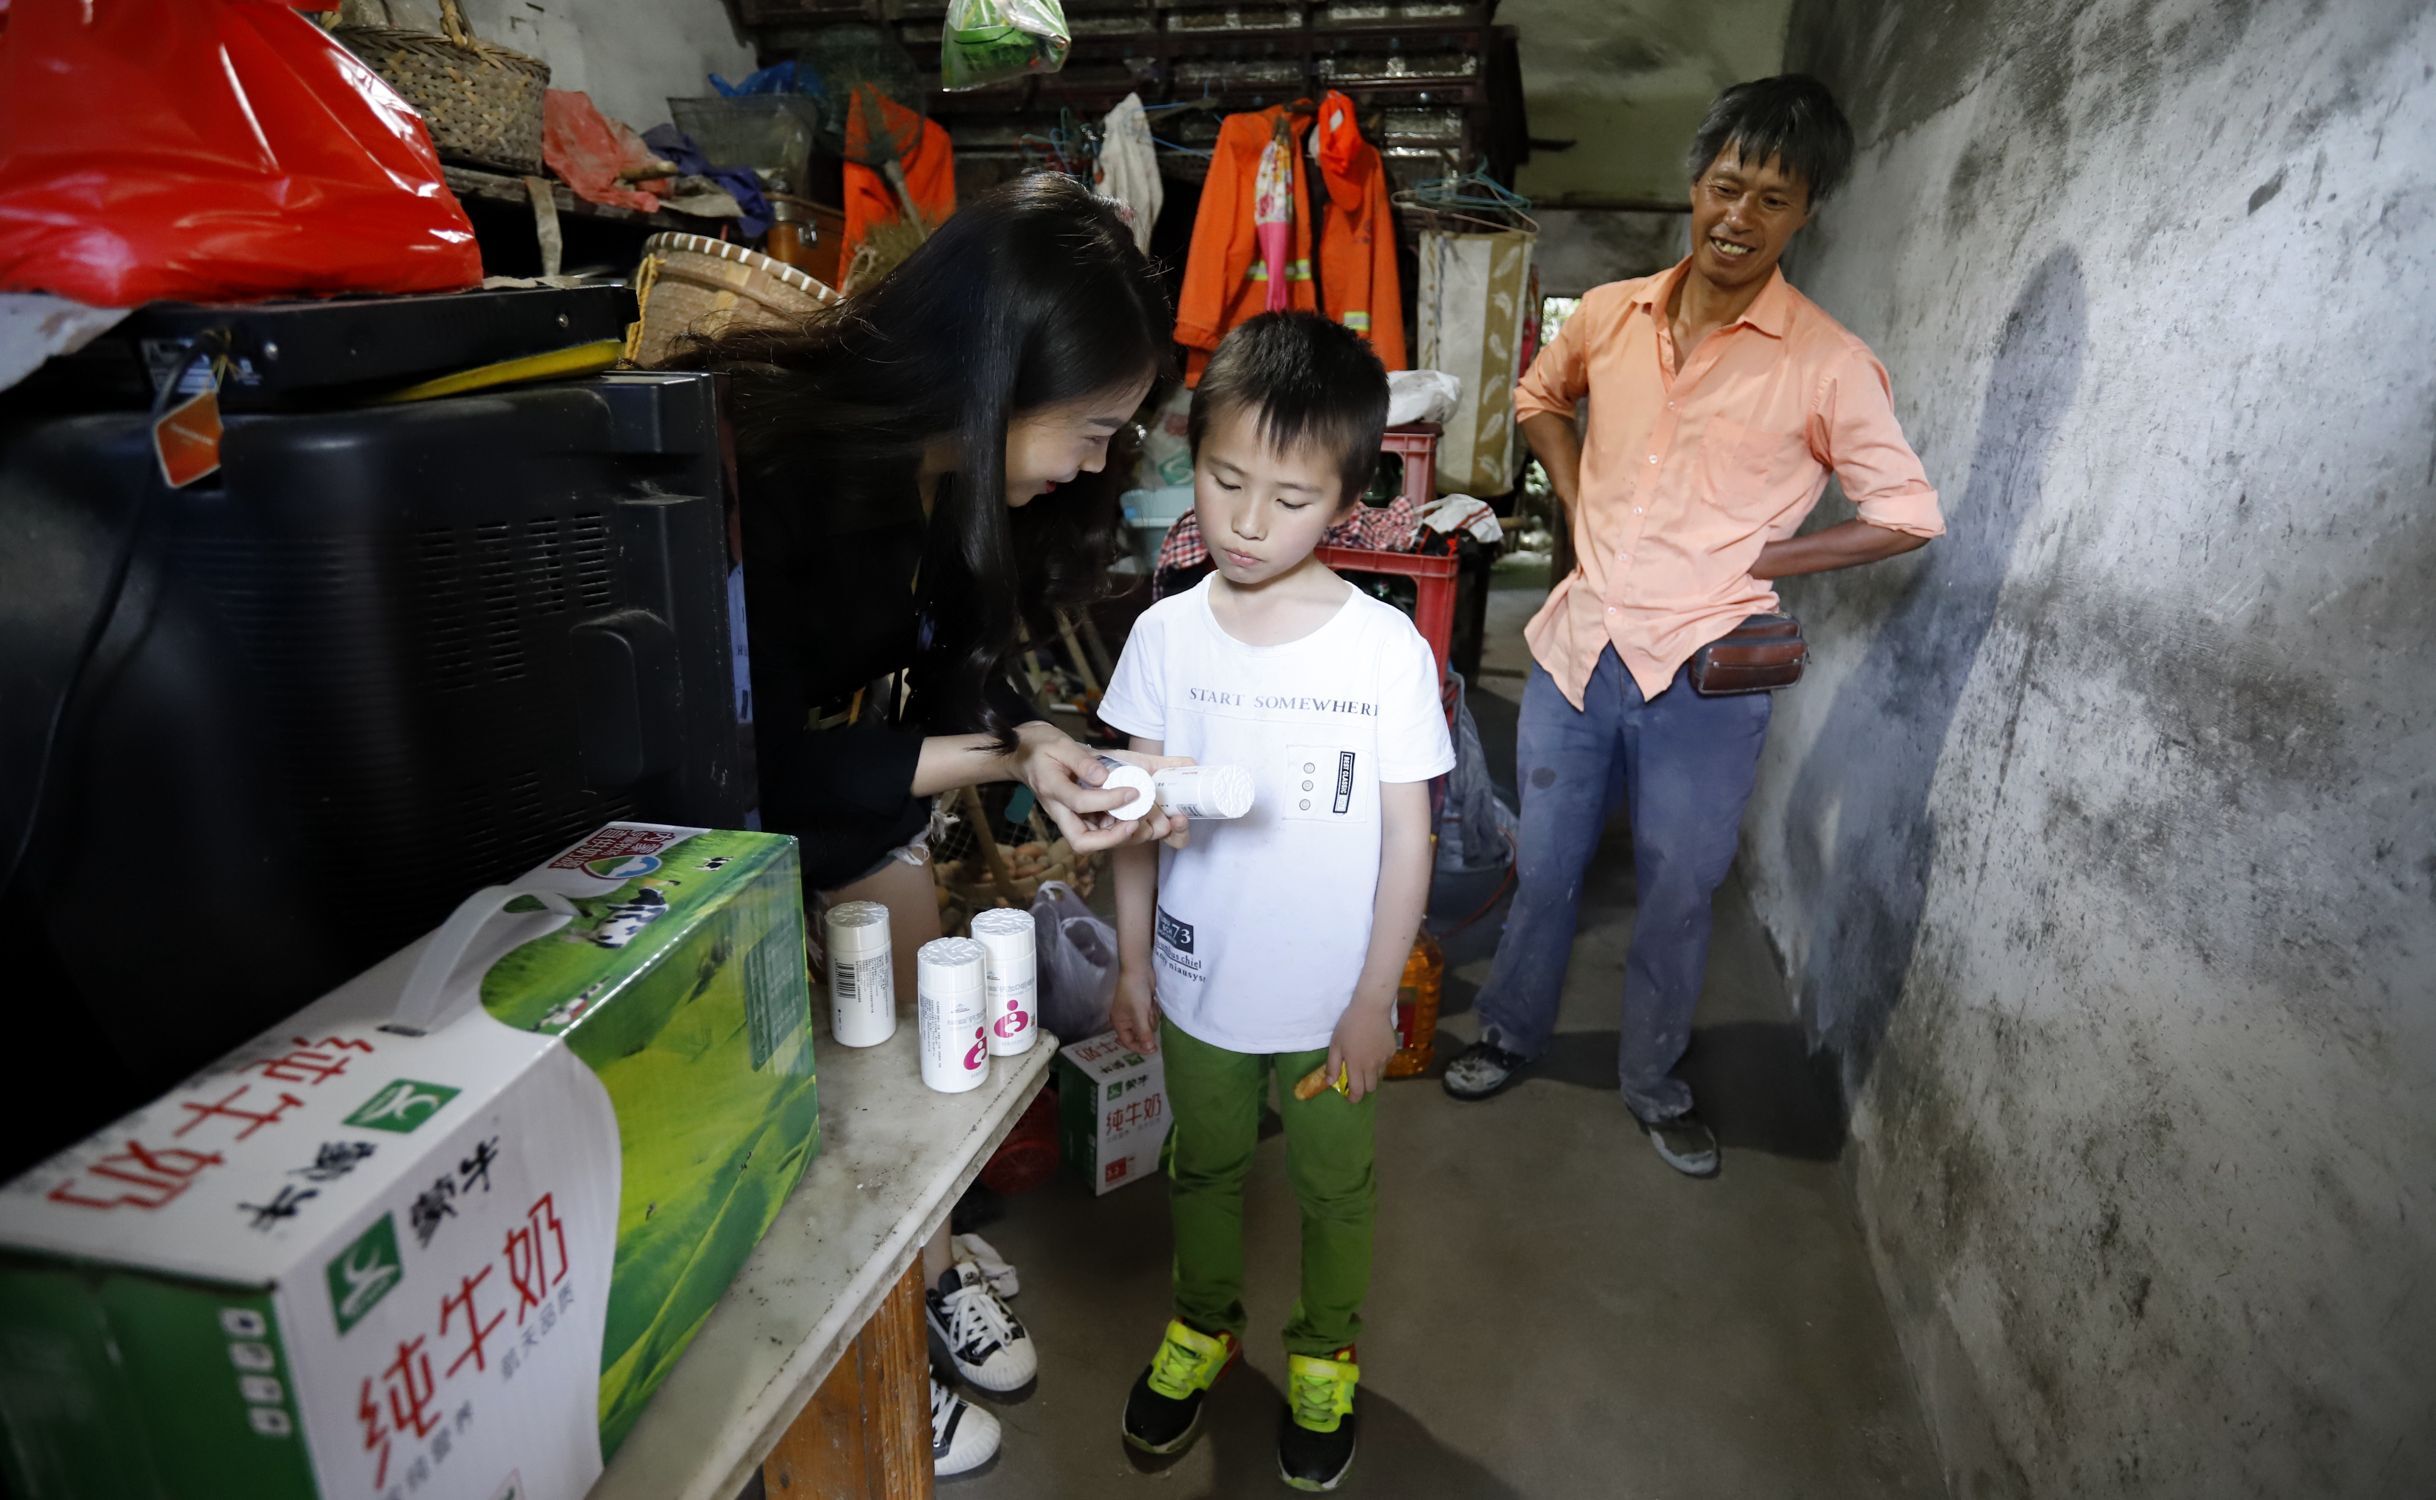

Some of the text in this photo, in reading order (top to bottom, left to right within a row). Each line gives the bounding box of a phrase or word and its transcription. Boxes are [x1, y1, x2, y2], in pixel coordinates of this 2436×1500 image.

[1190, 687, 1244, 706] START
[1342, 755, 1351, 771] BEST
[1340, 770, 1349, 795] CLASSIC
[1171, 923, 1191, 944] 73
[45, 1036, 375, 1211] 纯牛奶
[1104, 1092, 1162, 1137] 纯牛奶
[410, 1135, 499, 1249] 蒙牛
[358, 1191, 568, 1491] 纯牛奶
